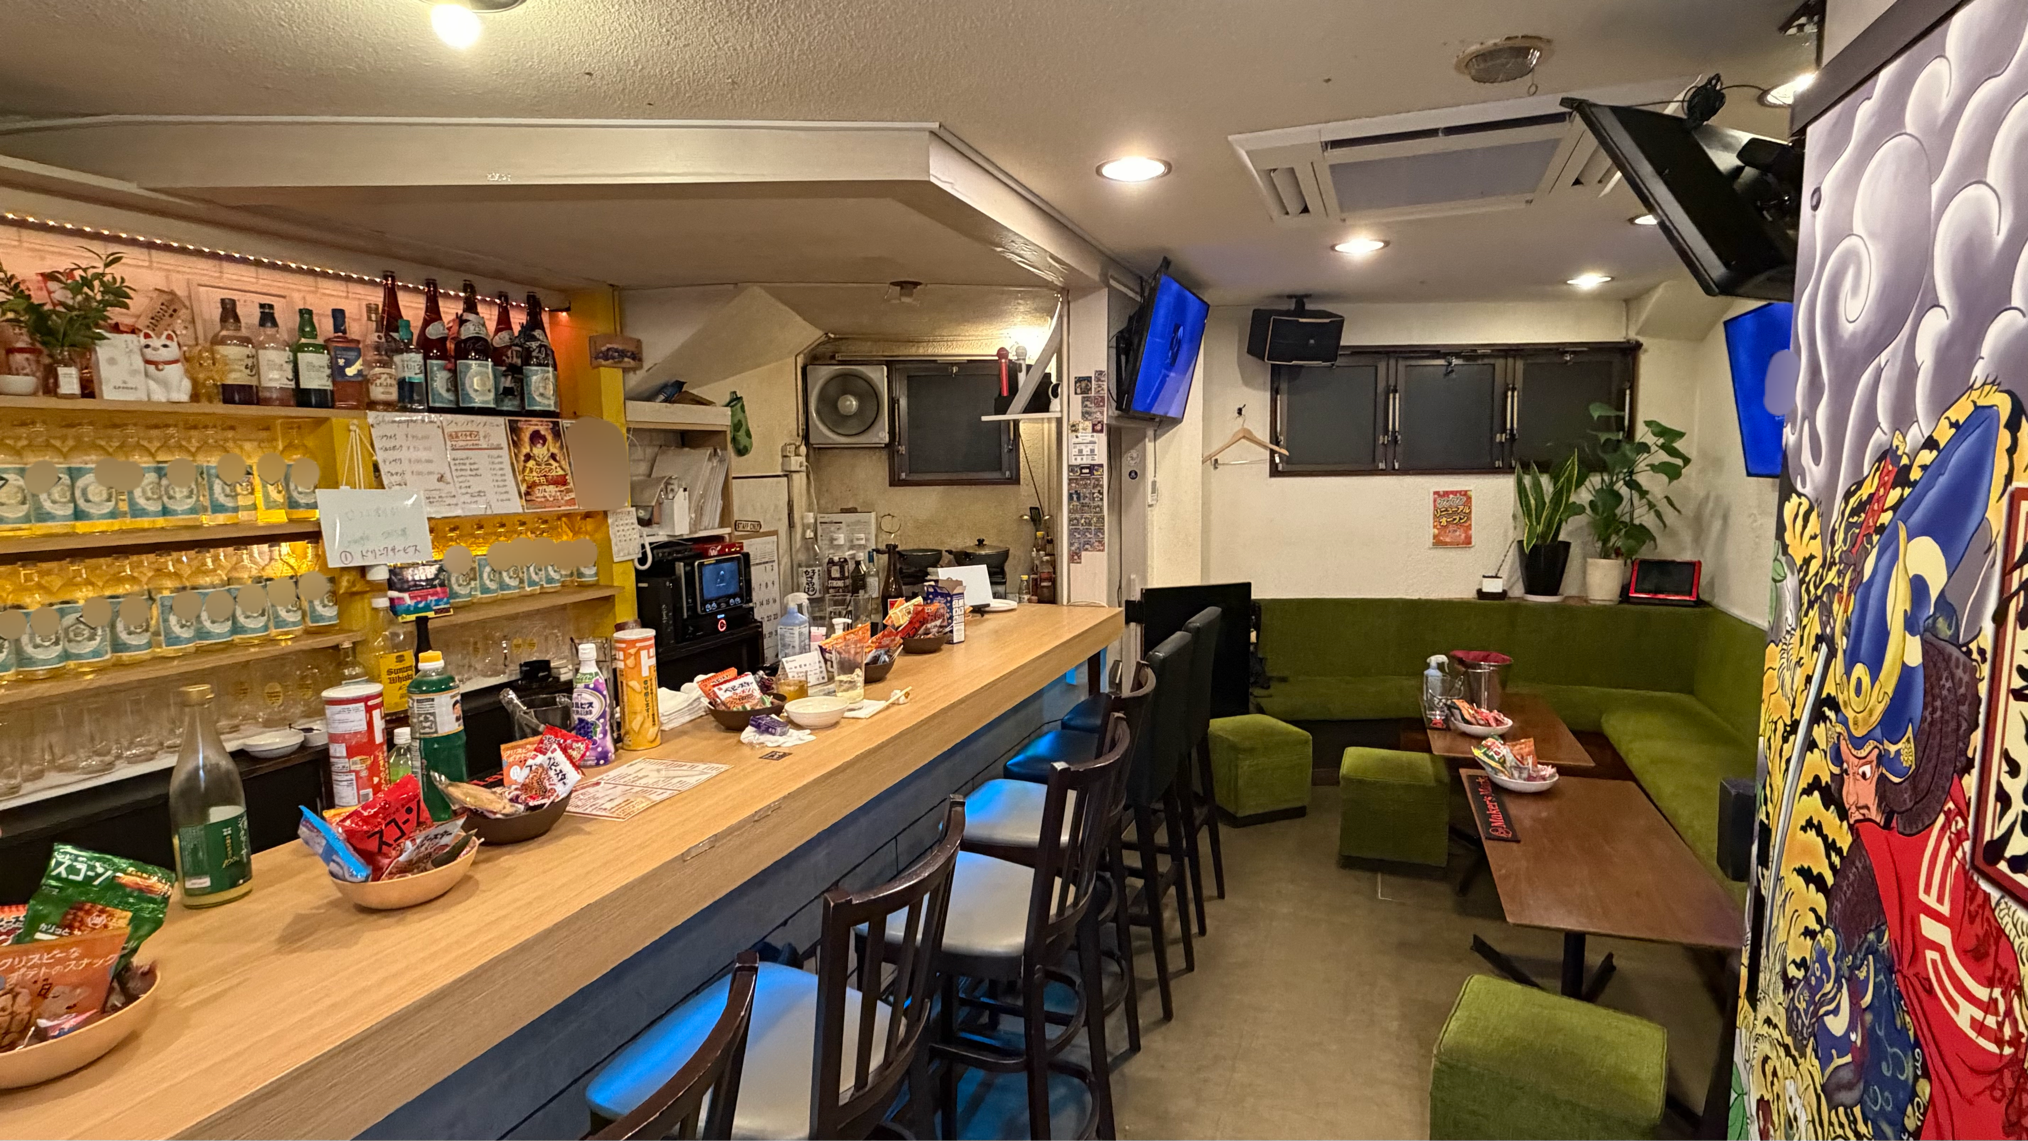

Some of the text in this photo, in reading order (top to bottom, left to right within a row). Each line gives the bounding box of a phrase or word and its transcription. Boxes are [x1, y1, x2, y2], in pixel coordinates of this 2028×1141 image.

[1434, 505, 1471, 518] リニューアル
[1439, 515, 1468, 526] オープン
[737, 522, 750, 530] STAFF
[723, 681, 754, 693] ベビースター
[366, 798, 421, 854] スコーン
[51, 858, 114, 885] スコーン
[0, 947, 82, 971] クリスピーな
[12, 953, 119, 982] ポテトのスナック
